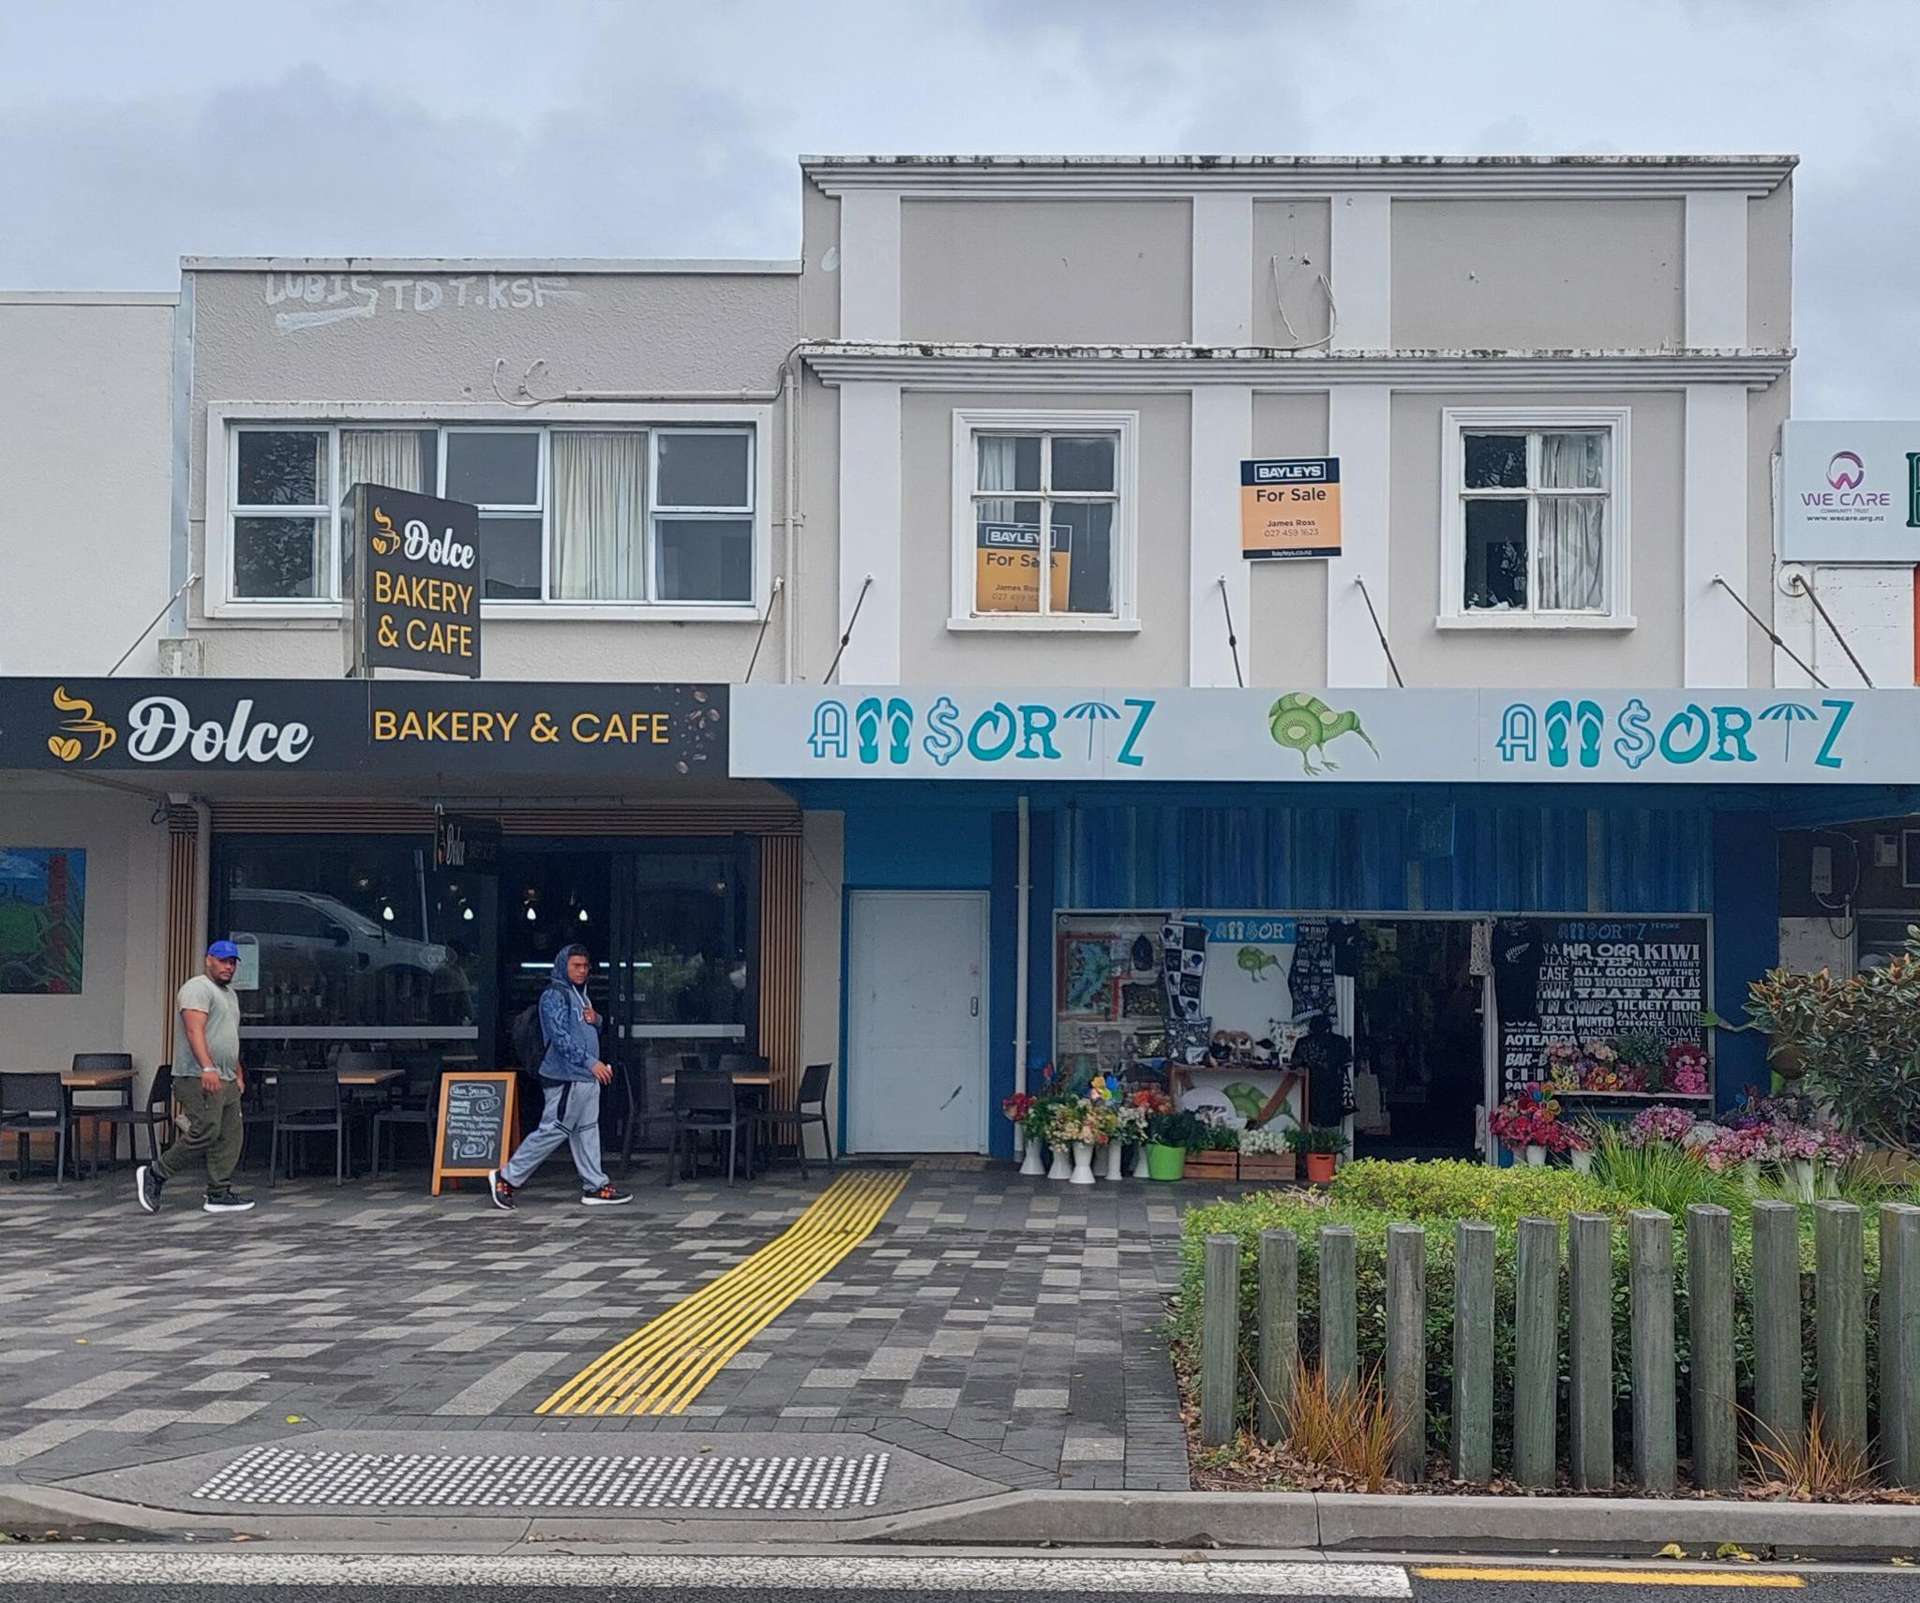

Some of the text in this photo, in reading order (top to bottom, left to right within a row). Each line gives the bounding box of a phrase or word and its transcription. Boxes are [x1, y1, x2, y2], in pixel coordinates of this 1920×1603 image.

[1258, 465, 1322, 479] BAYLEYS
[1256, 487, 1327, 503] For Sale
[1800, 493, 1891, 506] WE CARE
[1267, 519, 1316, 528] James Ross
[990, 531, 1041, 544] BAYLEY
[404, 520, 476, 570] Dolce
[986, 552, 1015, 568] For
[375, 570, 474, 615] BAKERY
[377, 614, 473, 657] & CAFE
[127, 696, 314, 764] Dolce
[374, 710, 670, 744] BAKERY & CAFE
[1597, 943, 1643, 960] ORA
[1644, 943, 1700, 960] KIWI
[1595, 957, 1632, 967] YEP
[1539, 967, 1570, 980] CASE
[1573, 967, 1648, 977] ALL GOOD
[1650, 968, 1672, 976] WOT
[1573, 977, 1592, 987] NO
[1655, 976, 1701, 988] SWEET AS
[1573, 988, 1702, 999] YEAH NAH
[1616, 1000, 1701, 1011] TICKETY BOO
[1576, 1016, 1615, 1027] MUNTED
[1616, 1011, 1665, 1020] PAKARU
[1505, 1034, 1578, 1046] AOTEAROA
